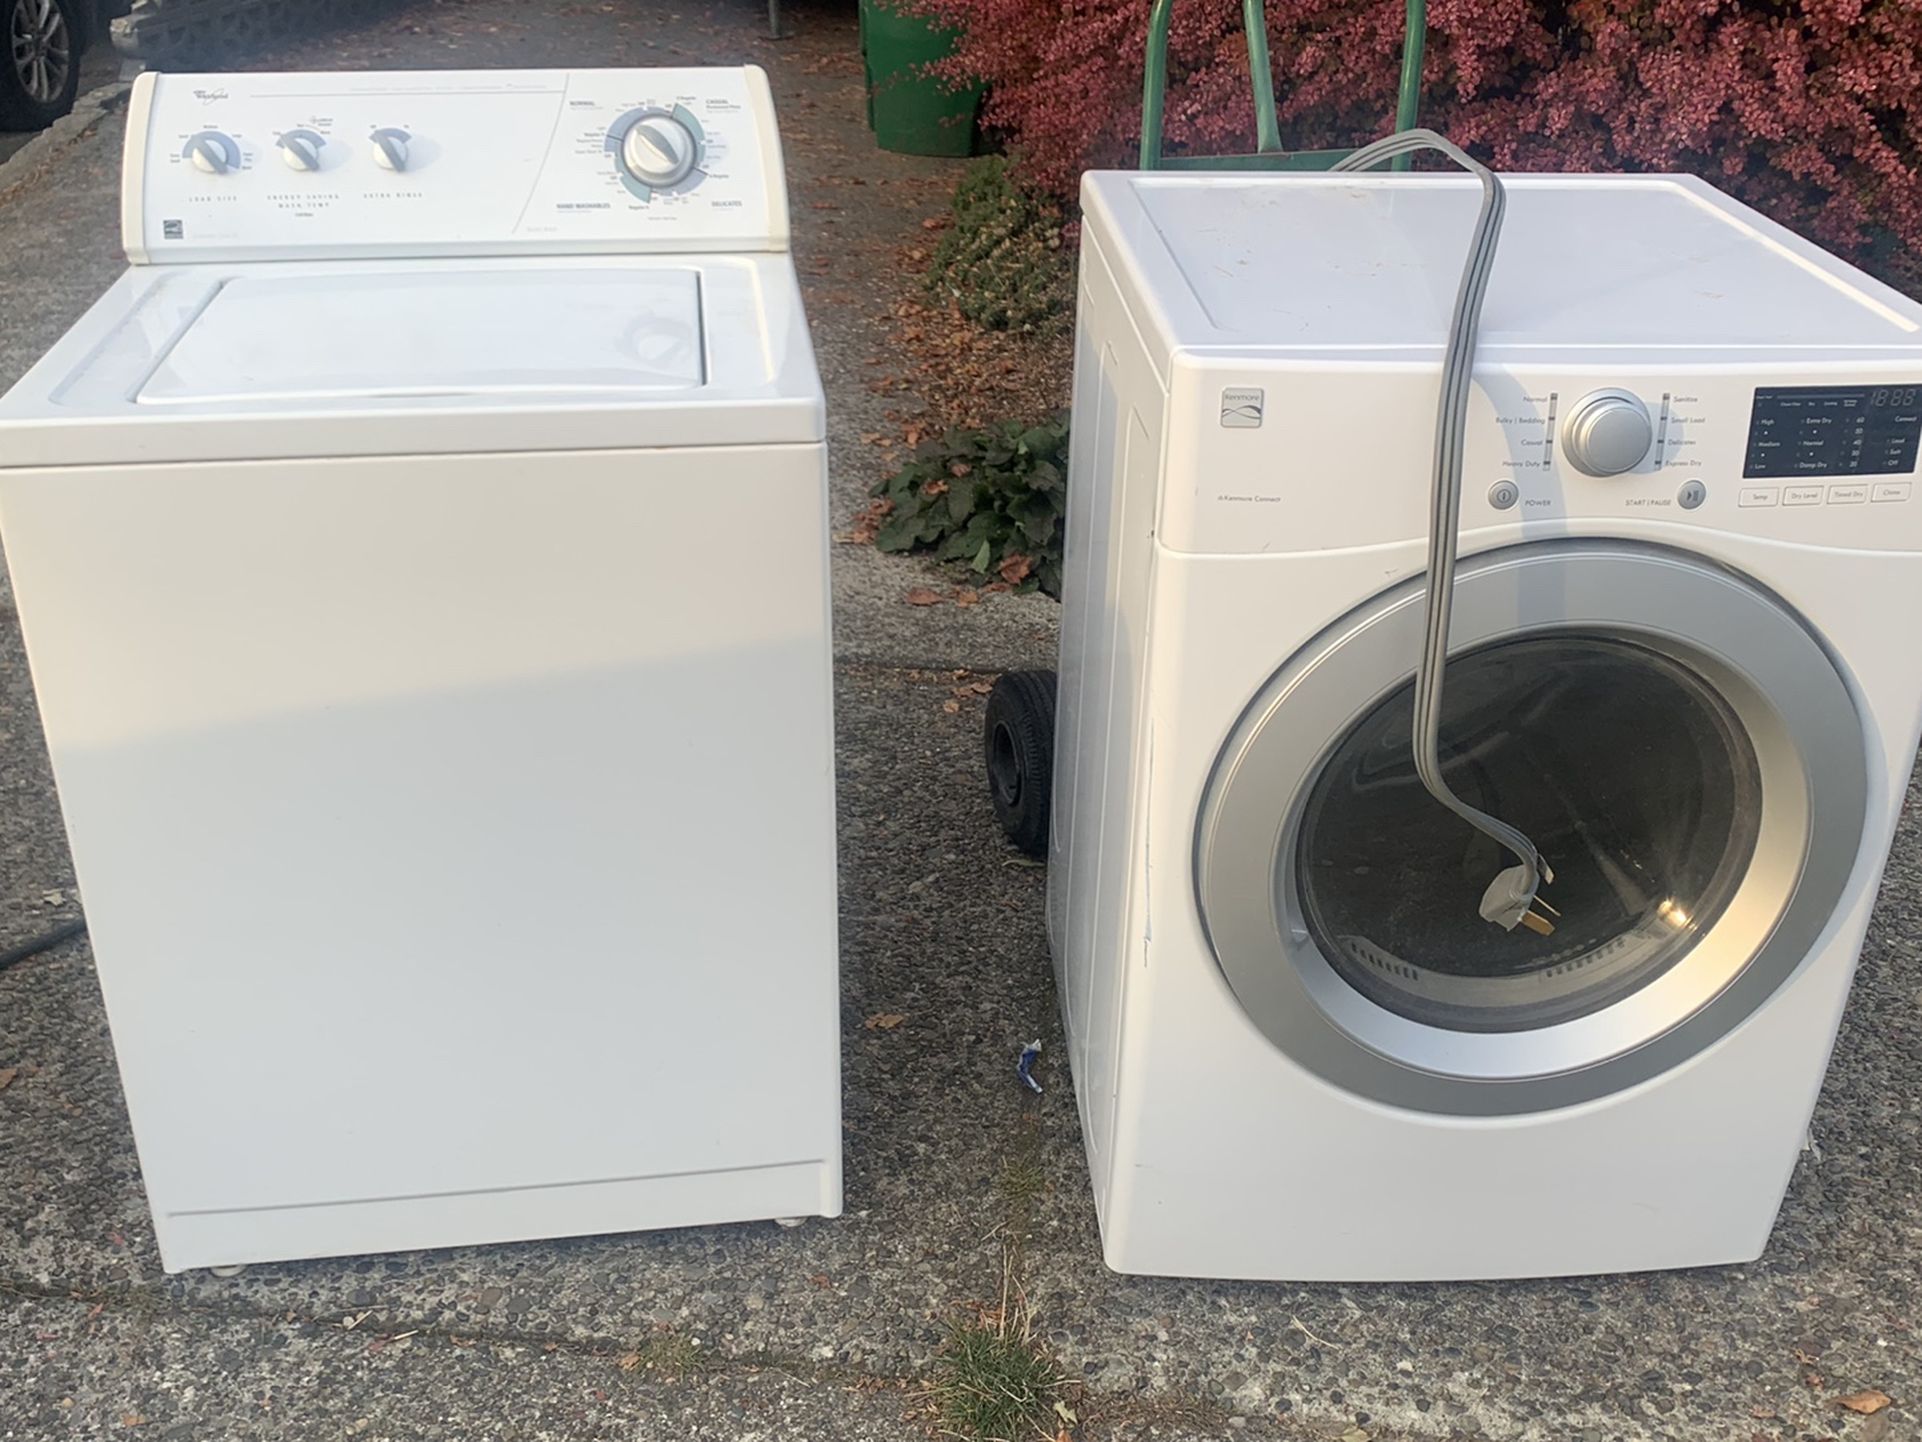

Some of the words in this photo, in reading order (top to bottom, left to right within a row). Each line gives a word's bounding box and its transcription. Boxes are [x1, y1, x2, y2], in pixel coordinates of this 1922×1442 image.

[1225, 393, 1259, 402] Kenmore
[1496, 416, 1513, 424] Bulky
[1519, 416, 1546, 424] Bedding
[1671, 416, 1689, 424] Small
[1822, 417, 1832, 425] Dry
[1668, 438, 1696, 446] Delicates
[1502, 460, 1523, 468] Heavy
[1853, 490, 1863, 498] Dry
